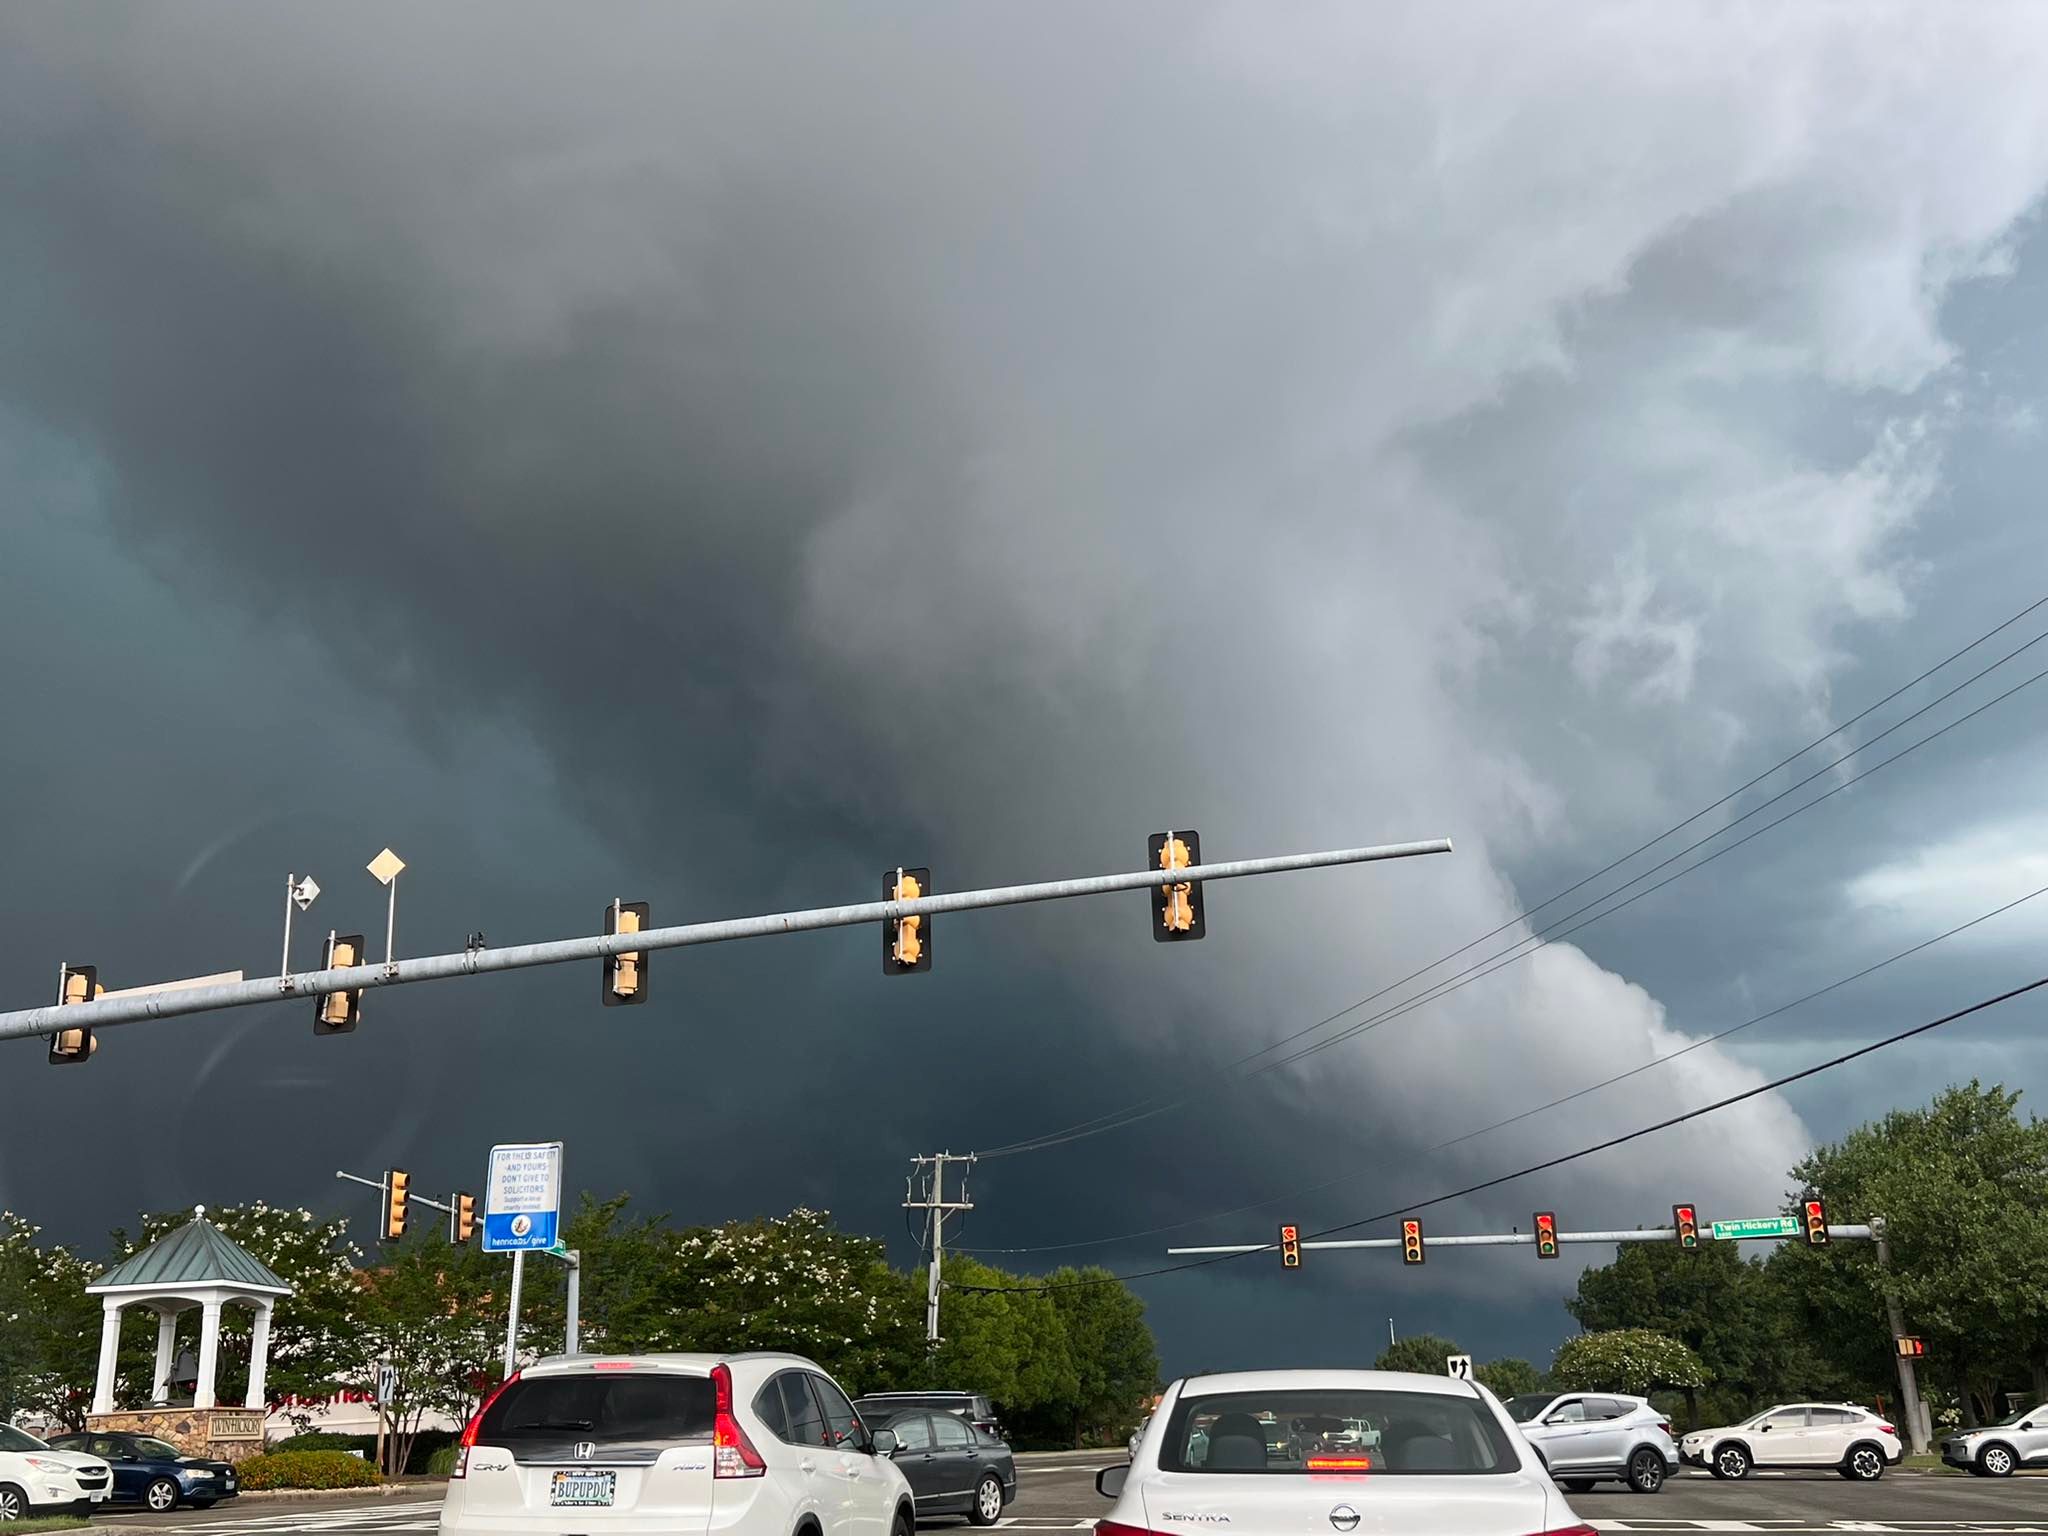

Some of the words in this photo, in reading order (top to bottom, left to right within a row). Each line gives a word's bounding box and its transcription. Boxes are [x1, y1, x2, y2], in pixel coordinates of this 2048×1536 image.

[497, 1152, 511, 1161] FOR
[523, 1174, 540, 1182] GIVE
[540, 1173, 550, 1182] TO
[503, 1184, 545, 1195] SOLICITORS
[1717, 1222, 1741, 1232] Twin
[1742, 1220, 1779, 1230] Hickory
[1780, 1218, 1793, 1228] Rd
[557, 1481, 609, 1498] BUPUPDU
[1162, 1512, 1231, 1523] SENTRA
